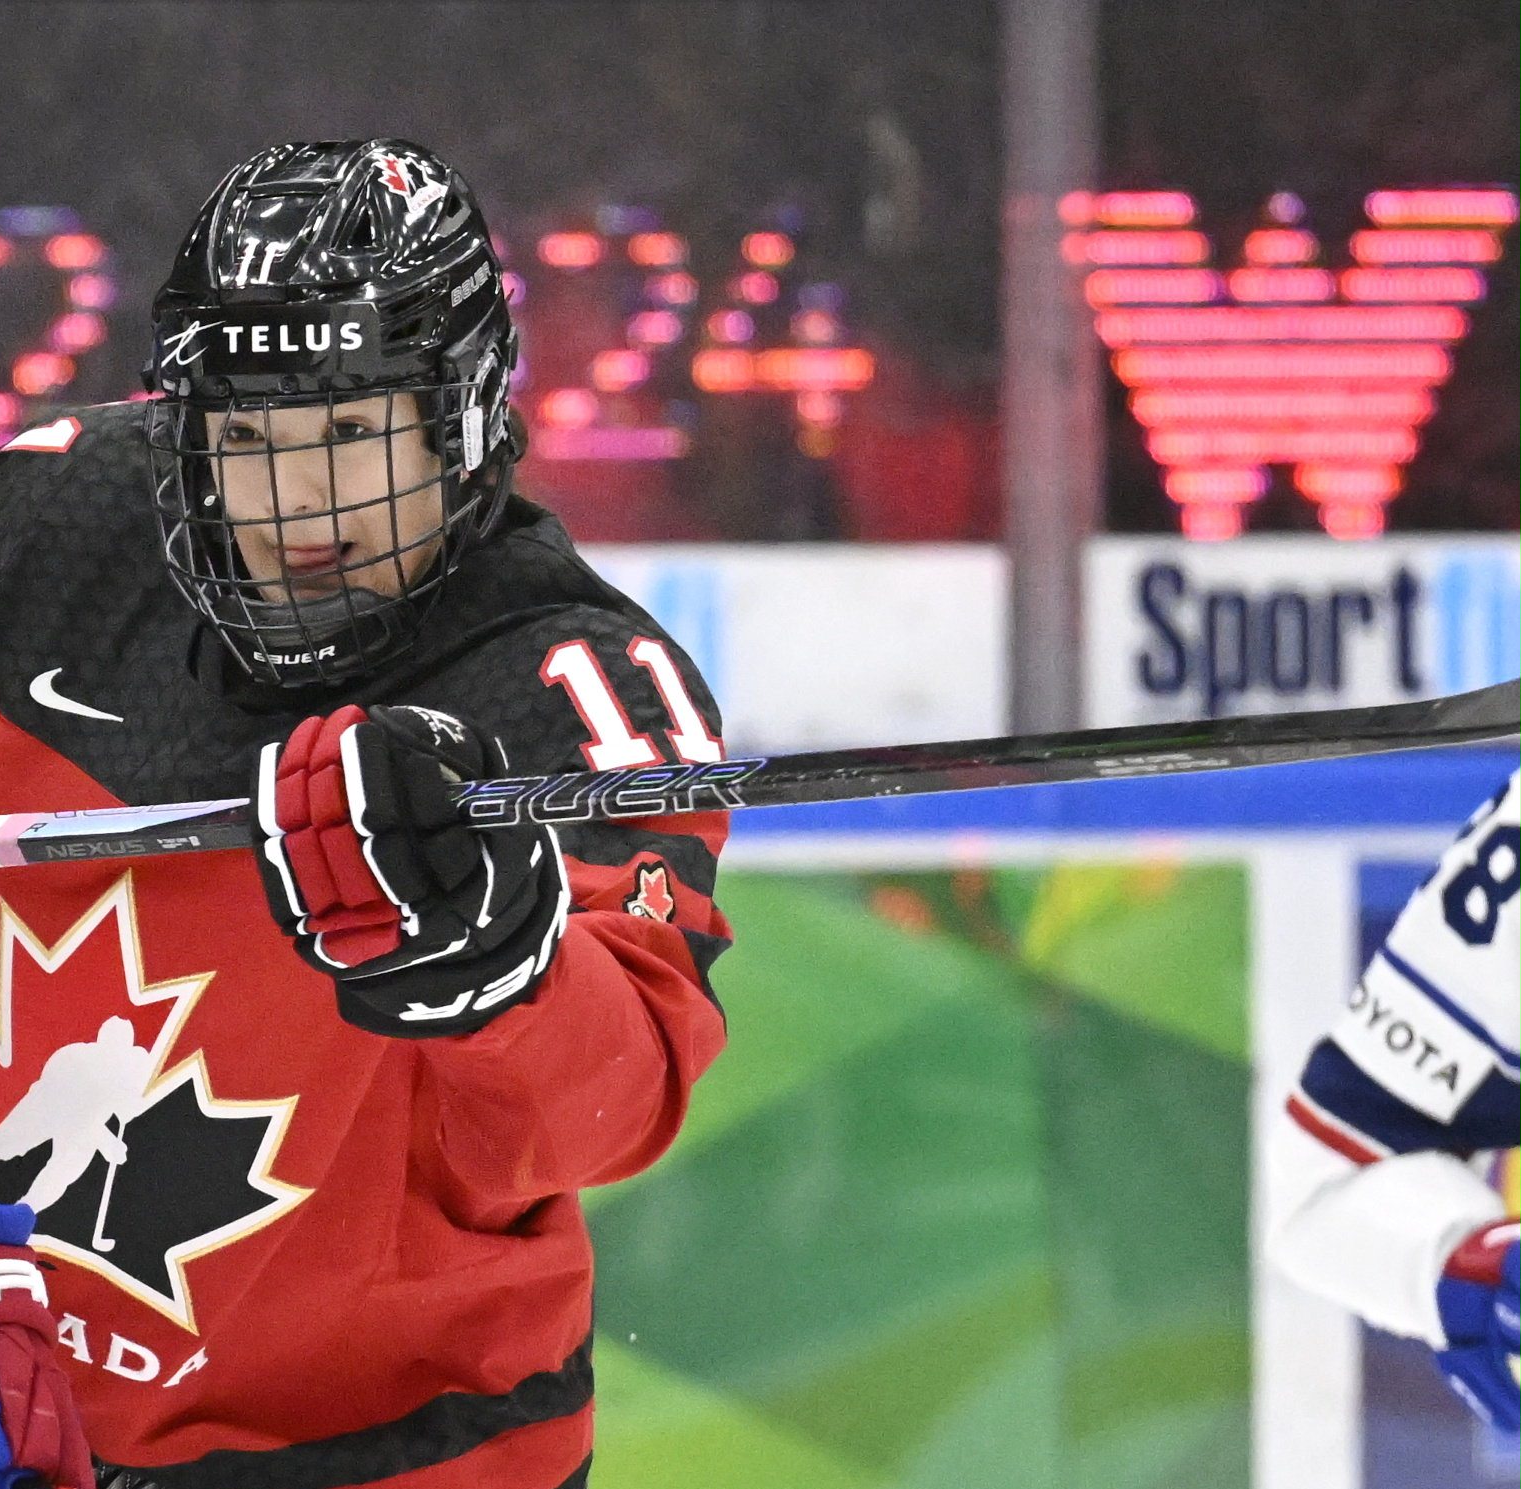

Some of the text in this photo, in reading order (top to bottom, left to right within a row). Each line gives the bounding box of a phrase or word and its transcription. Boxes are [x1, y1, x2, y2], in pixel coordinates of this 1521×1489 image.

[450, 261, 493, 308] BAUER
[222, 322, 363, 354] TELUS
[253, 645, 336, 665] BAUER
[537, 637, 726, 772] 11
[452, 757, 769, 828] AUER
[1347, 979, 1460, 1092] OYOTA
[57, 1312, 209, 1388] ADA
